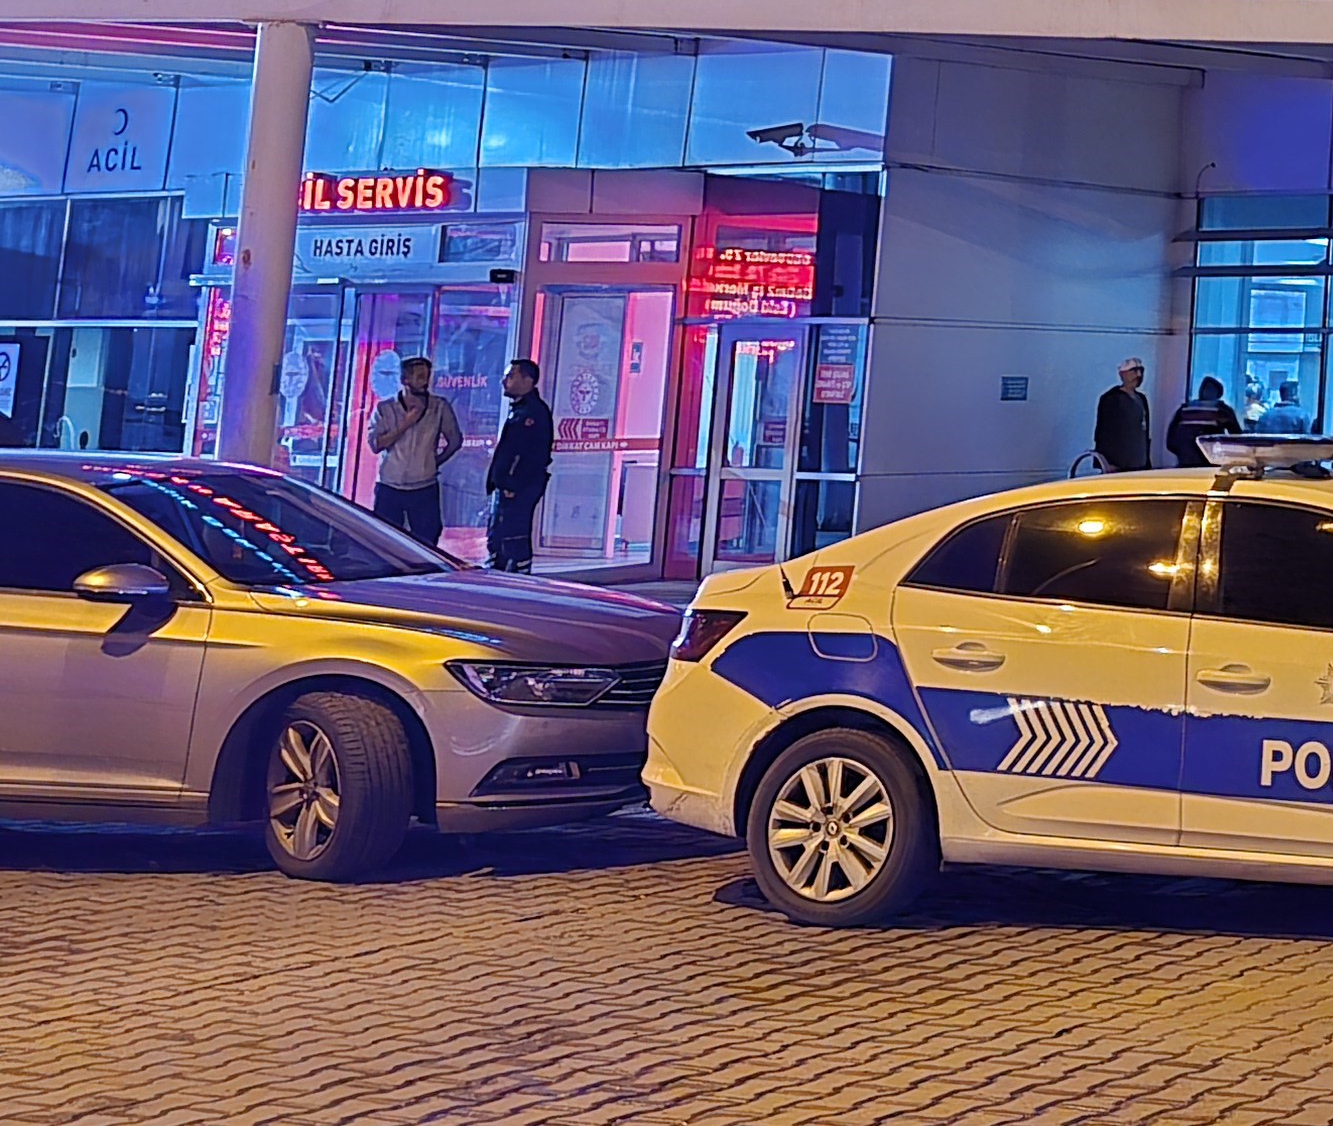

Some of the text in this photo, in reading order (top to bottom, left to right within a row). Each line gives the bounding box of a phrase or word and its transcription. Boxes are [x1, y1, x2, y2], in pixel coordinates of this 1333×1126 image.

[87, 141, 142, 172] ACİL
[299, 169, 444, 210] İL SERVİS
[313, 233, 412, 259] HASTA GİRİŞ
[808, 571, 845, 595] 112
